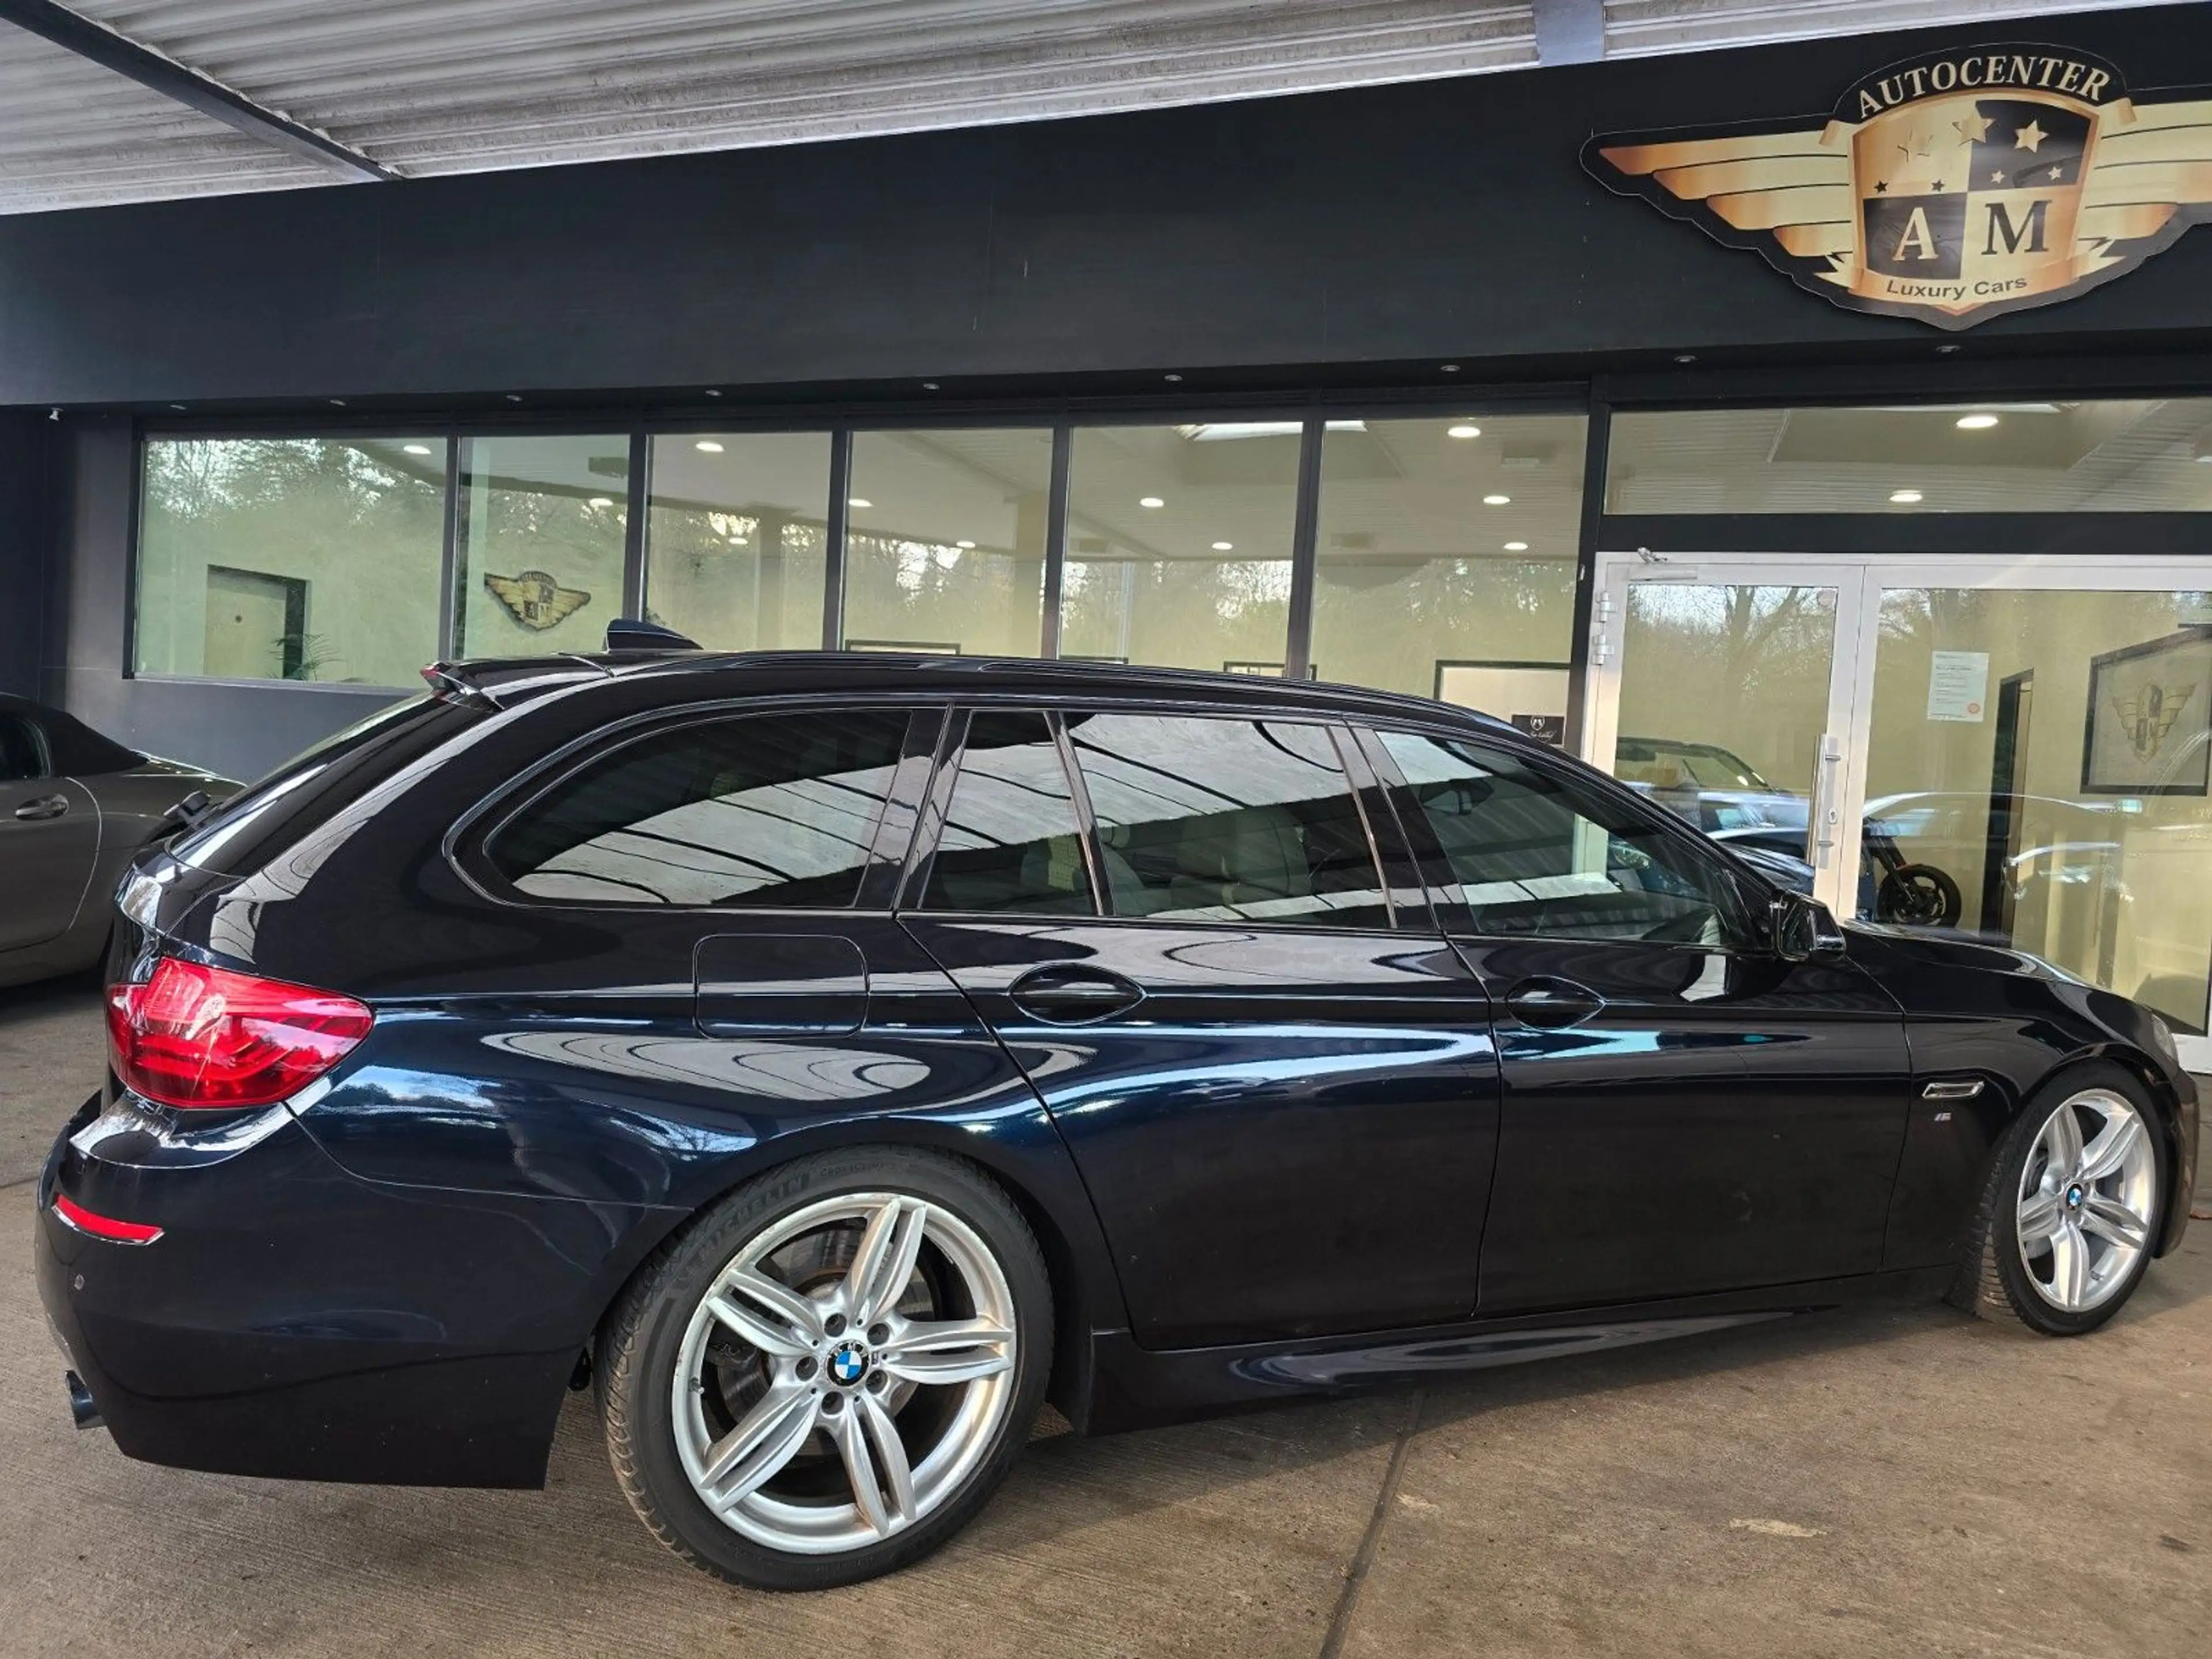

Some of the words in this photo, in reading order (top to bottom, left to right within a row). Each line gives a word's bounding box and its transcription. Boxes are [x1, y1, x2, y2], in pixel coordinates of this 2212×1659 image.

[1859, 55, 2111, 119] AUTOCENTER
[1892, 207, 1940, 261] A
[1980, 199, 2053, 256] M
[1886, 279, 1967, 301] Luxury
[1974, 277, 2028, 296] Cars
